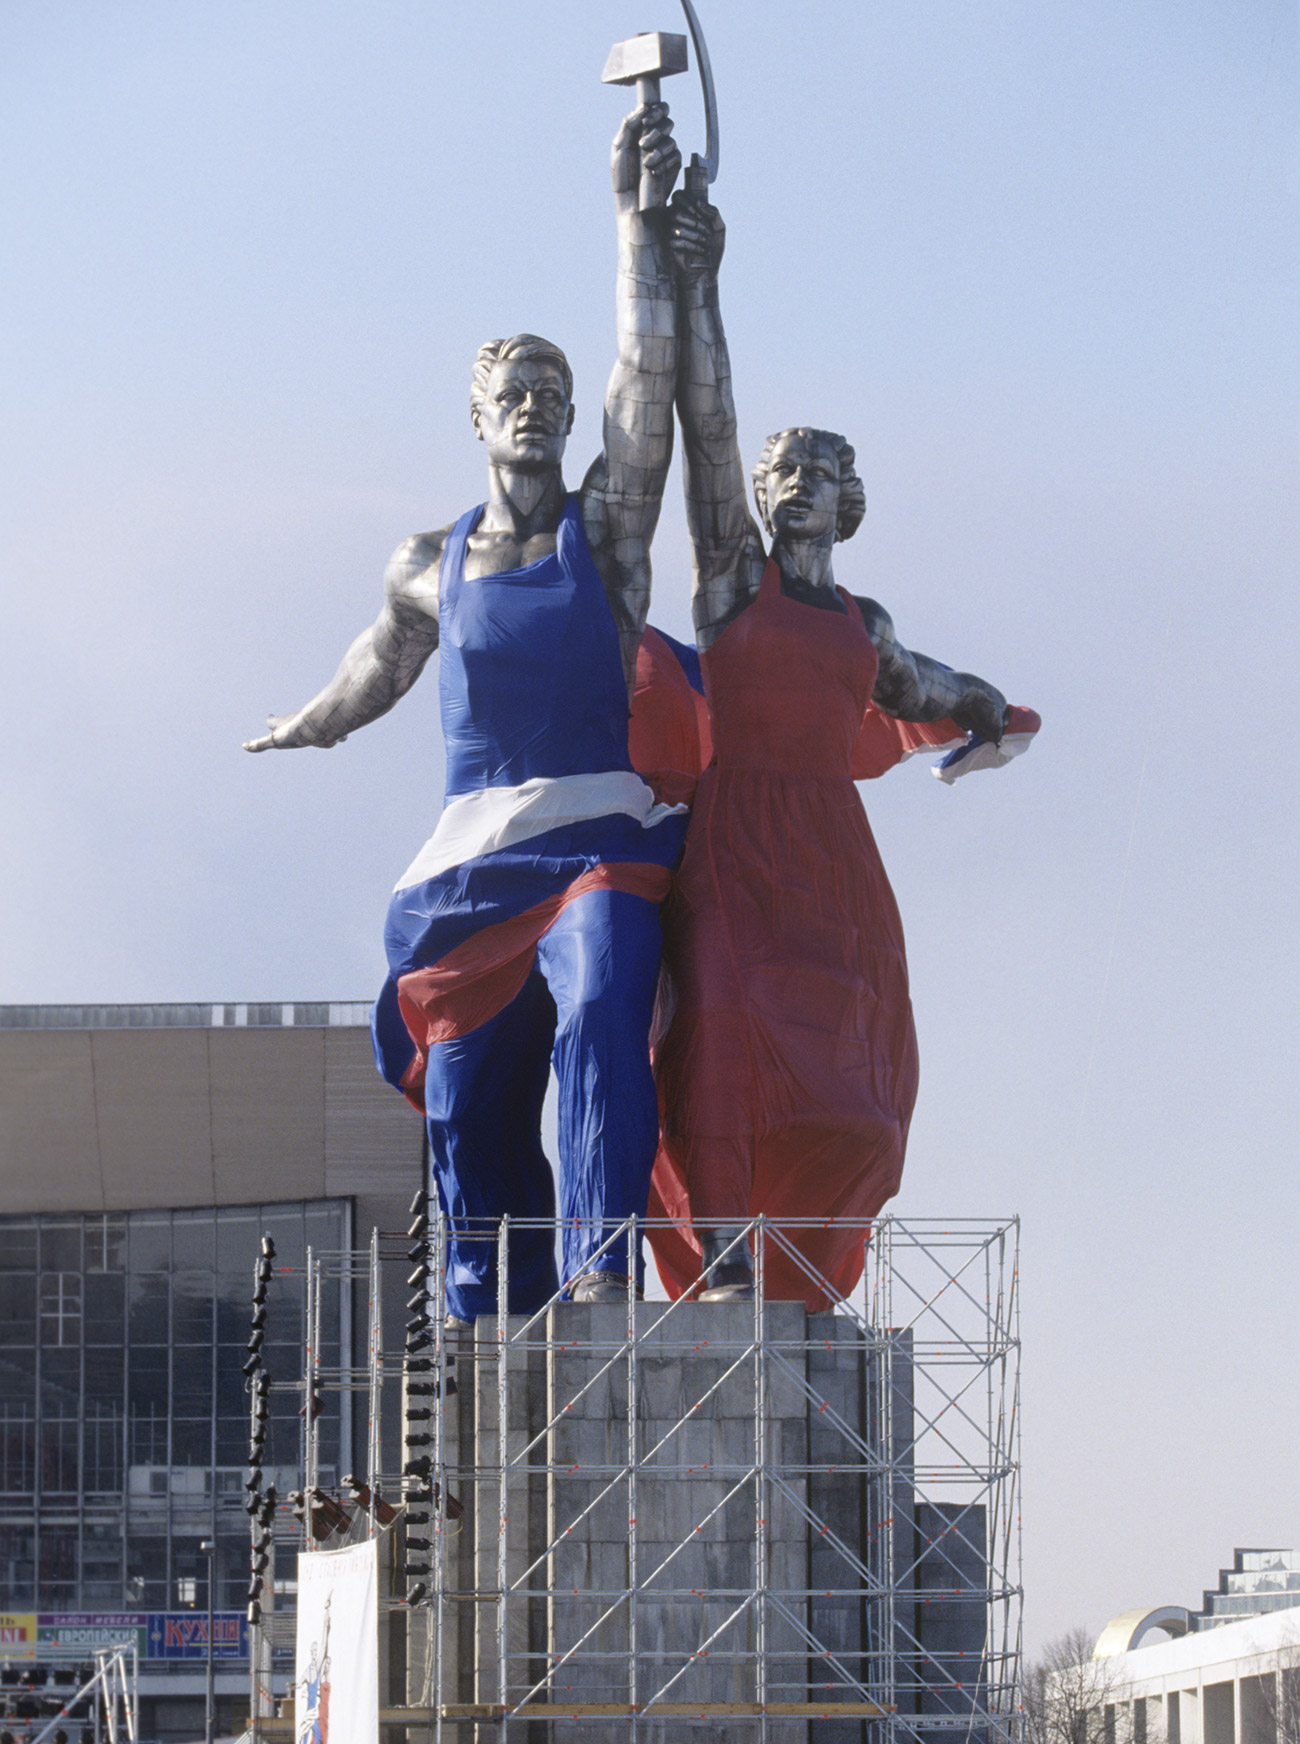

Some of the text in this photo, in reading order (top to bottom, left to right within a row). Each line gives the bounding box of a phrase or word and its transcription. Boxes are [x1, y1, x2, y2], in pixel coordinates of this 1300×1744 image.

[53, 1615, 139, 1625] САЛОН МЕБЕЛИ
[58, 1628, 138, 1643] ЕВРОПЕЙСКИЙ
[165, 1619, 240, 1647] КУХНИ
